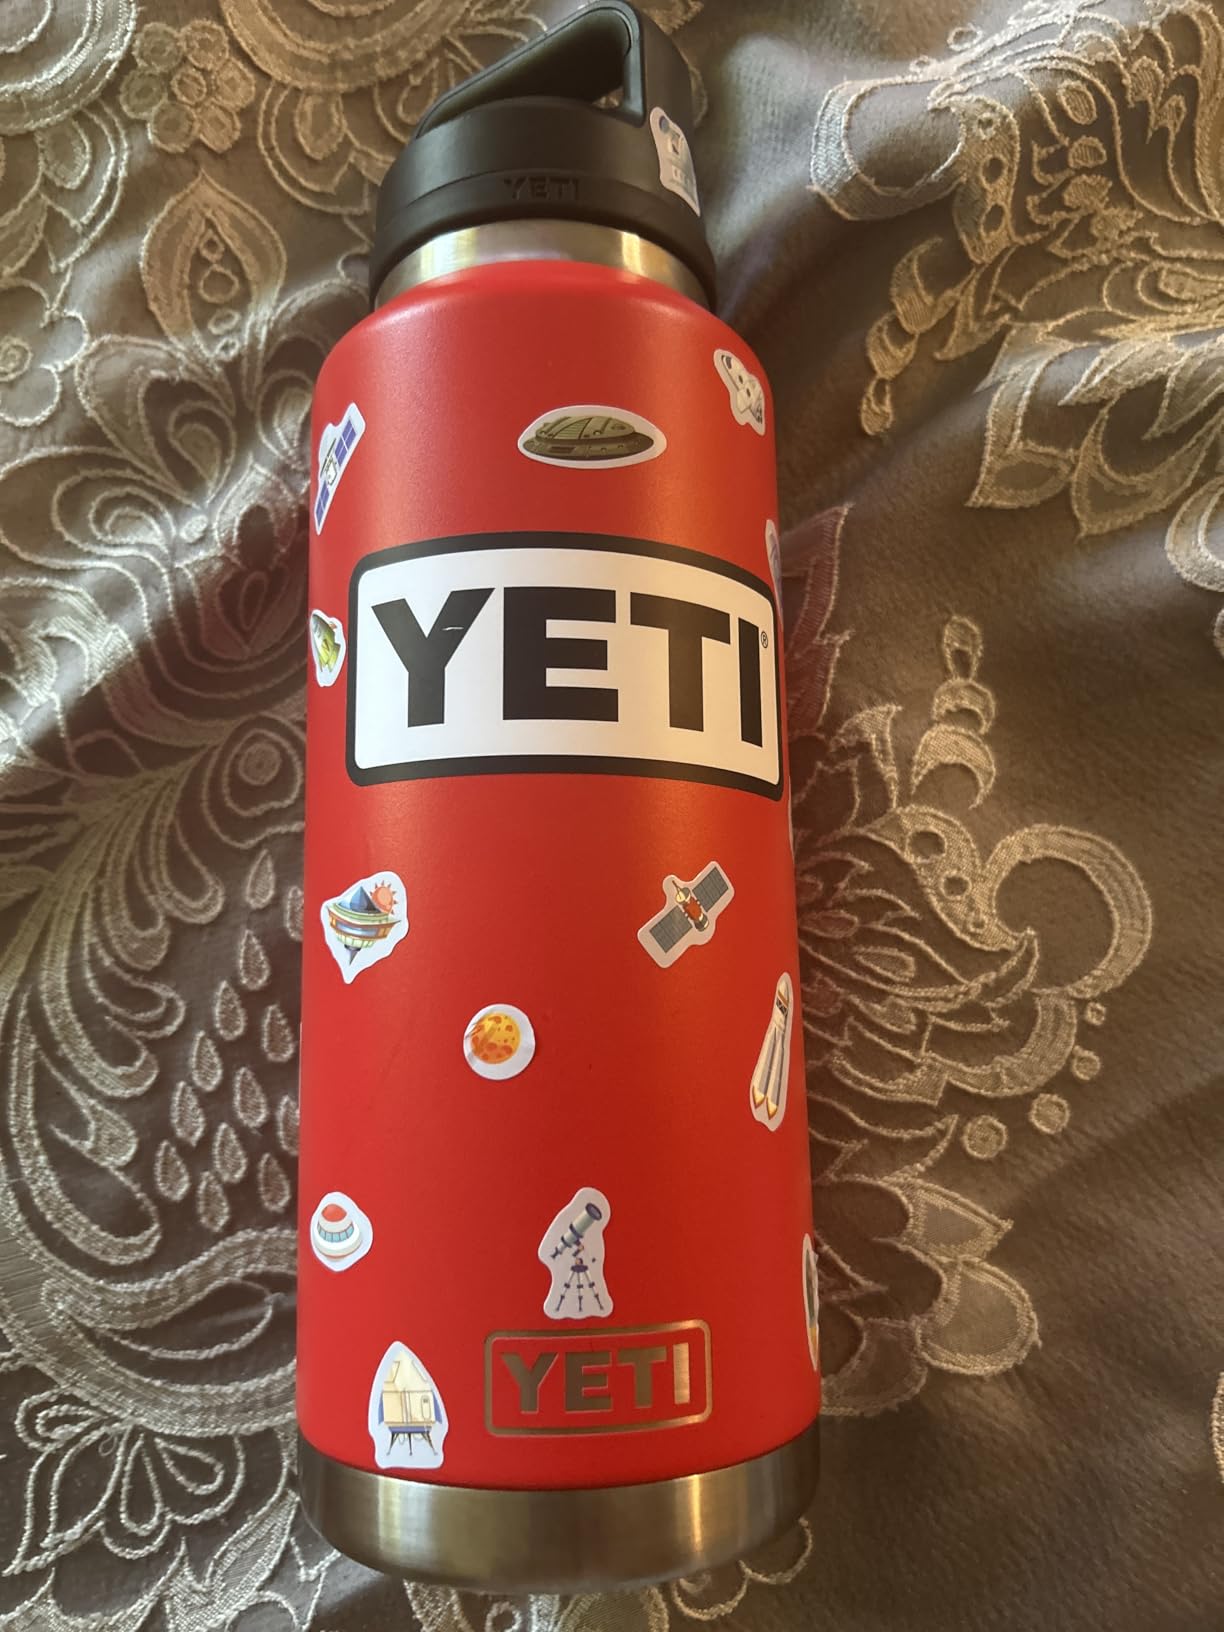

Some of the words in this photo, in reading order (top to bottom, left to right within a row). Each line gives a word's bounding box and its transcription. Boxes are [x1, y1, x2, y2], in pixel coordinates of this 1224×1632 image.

[504, 176, 580, 200] YETI
[371, 587, 763, 748] YETI
[502, 1342, 690, 1414] YETI
